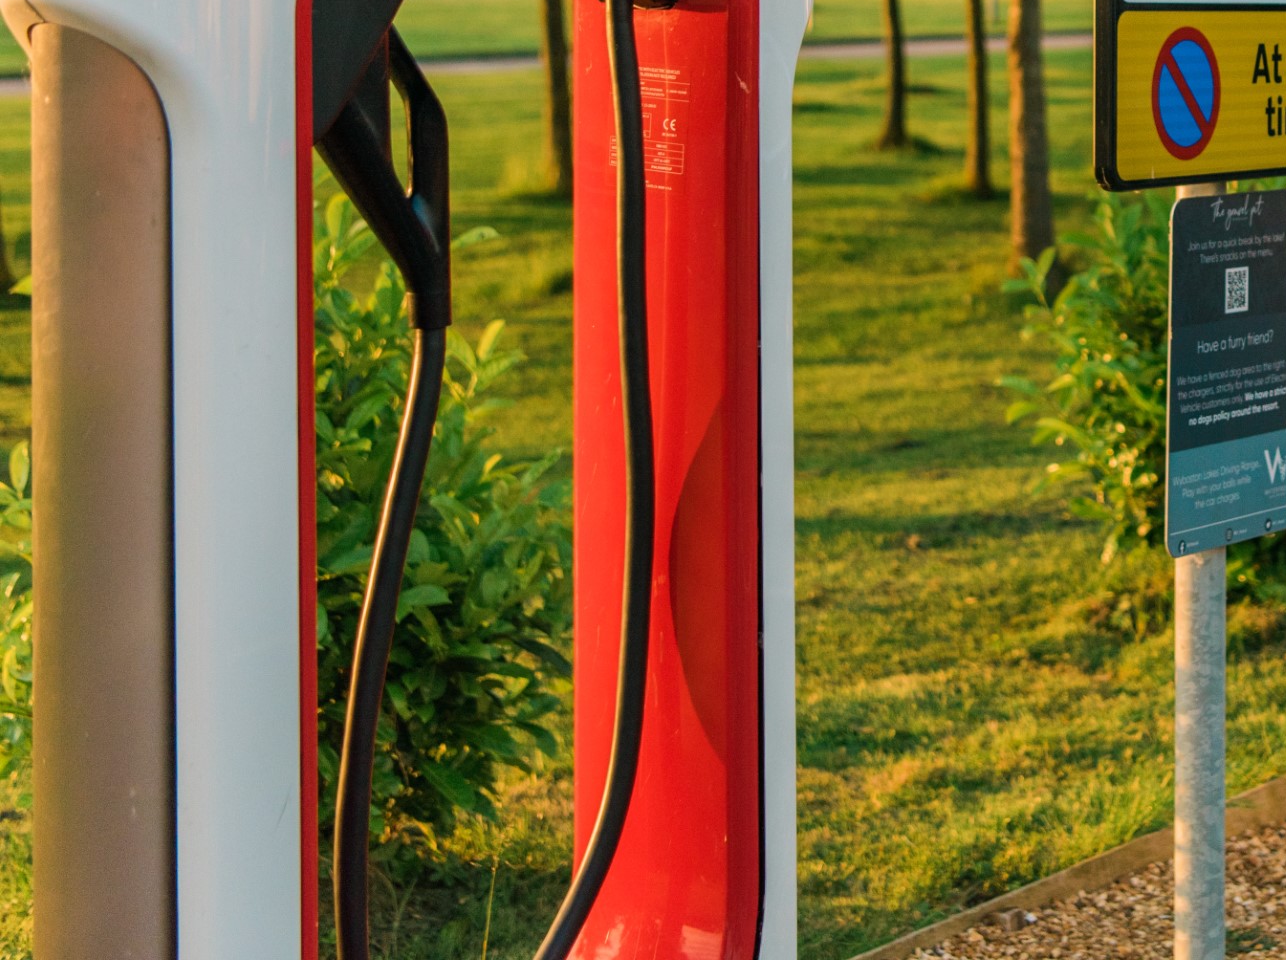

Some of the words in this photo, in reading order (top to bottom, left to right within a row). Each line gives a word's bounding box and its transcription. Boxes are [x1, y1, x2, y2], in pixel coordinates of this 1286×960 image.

[1251, 43, 1283, 84] At
[662, 118, 677, 132] CE
[1210, 196, 1225, 223] The
[1188, 241, 1200, 252] Join
[1201, 242, 1208, 250] us
[1208, 240, 1216, 249] for
[1223, 238, 1237, 248] quick
[1238, 236, 1253, 246] break
[1254, 235, 1262, 246] by
[1263, 234, 1271, 243] the
[1219, 251, 1238, 262] snacks
[1239, 251, 1247, 260] on
[1247, 249, 1257, 258] the
[1197, 340, 1219, 354] Have
[1220, 340, 1227, 350] a
[1228, 335, 1247, 350] furry
[1247, 329, 1274, 346] friend?
[1177, 375, 1187, 386] We
[1187, 374, 1202, 385] have
[1208, 371, 1229, 382] fenced
[1229, 369, 1242, 380] dog
[1242, 366, 1256, 376] area
[1256, 364, 1262, 373] to
[1263, 362, 1272, 371] the
[1272, 360, 1285, 372] right
[1177, 390, 1188, 400] the
[1215, 382, 1235, 394] strictly
[1235, 380, 1243, 390] for
[1244, 378, 1253, 388] the
[1254, 377, 1264, 387] use
[1180, 401, 1200, 414] Vehicle
[1202, 396, 1230, 410] customers
[1244, 392, 1254, 402] We
[1254, 389, 1269, 400] have
[1188, 417, 1197, 426] no
[1198, 414, 1213, 426] dogs
[1213, 410, 1230, 423] policy
[1231, 405, 1251, 418] around
[1252, 403, 1261, 414] the
[1182, 486, 1195, 499] Play
[1209, 482, 1221, 494] your
[1195, 499, 1205, 509] the
[1206, 497, 1215, 507] car
